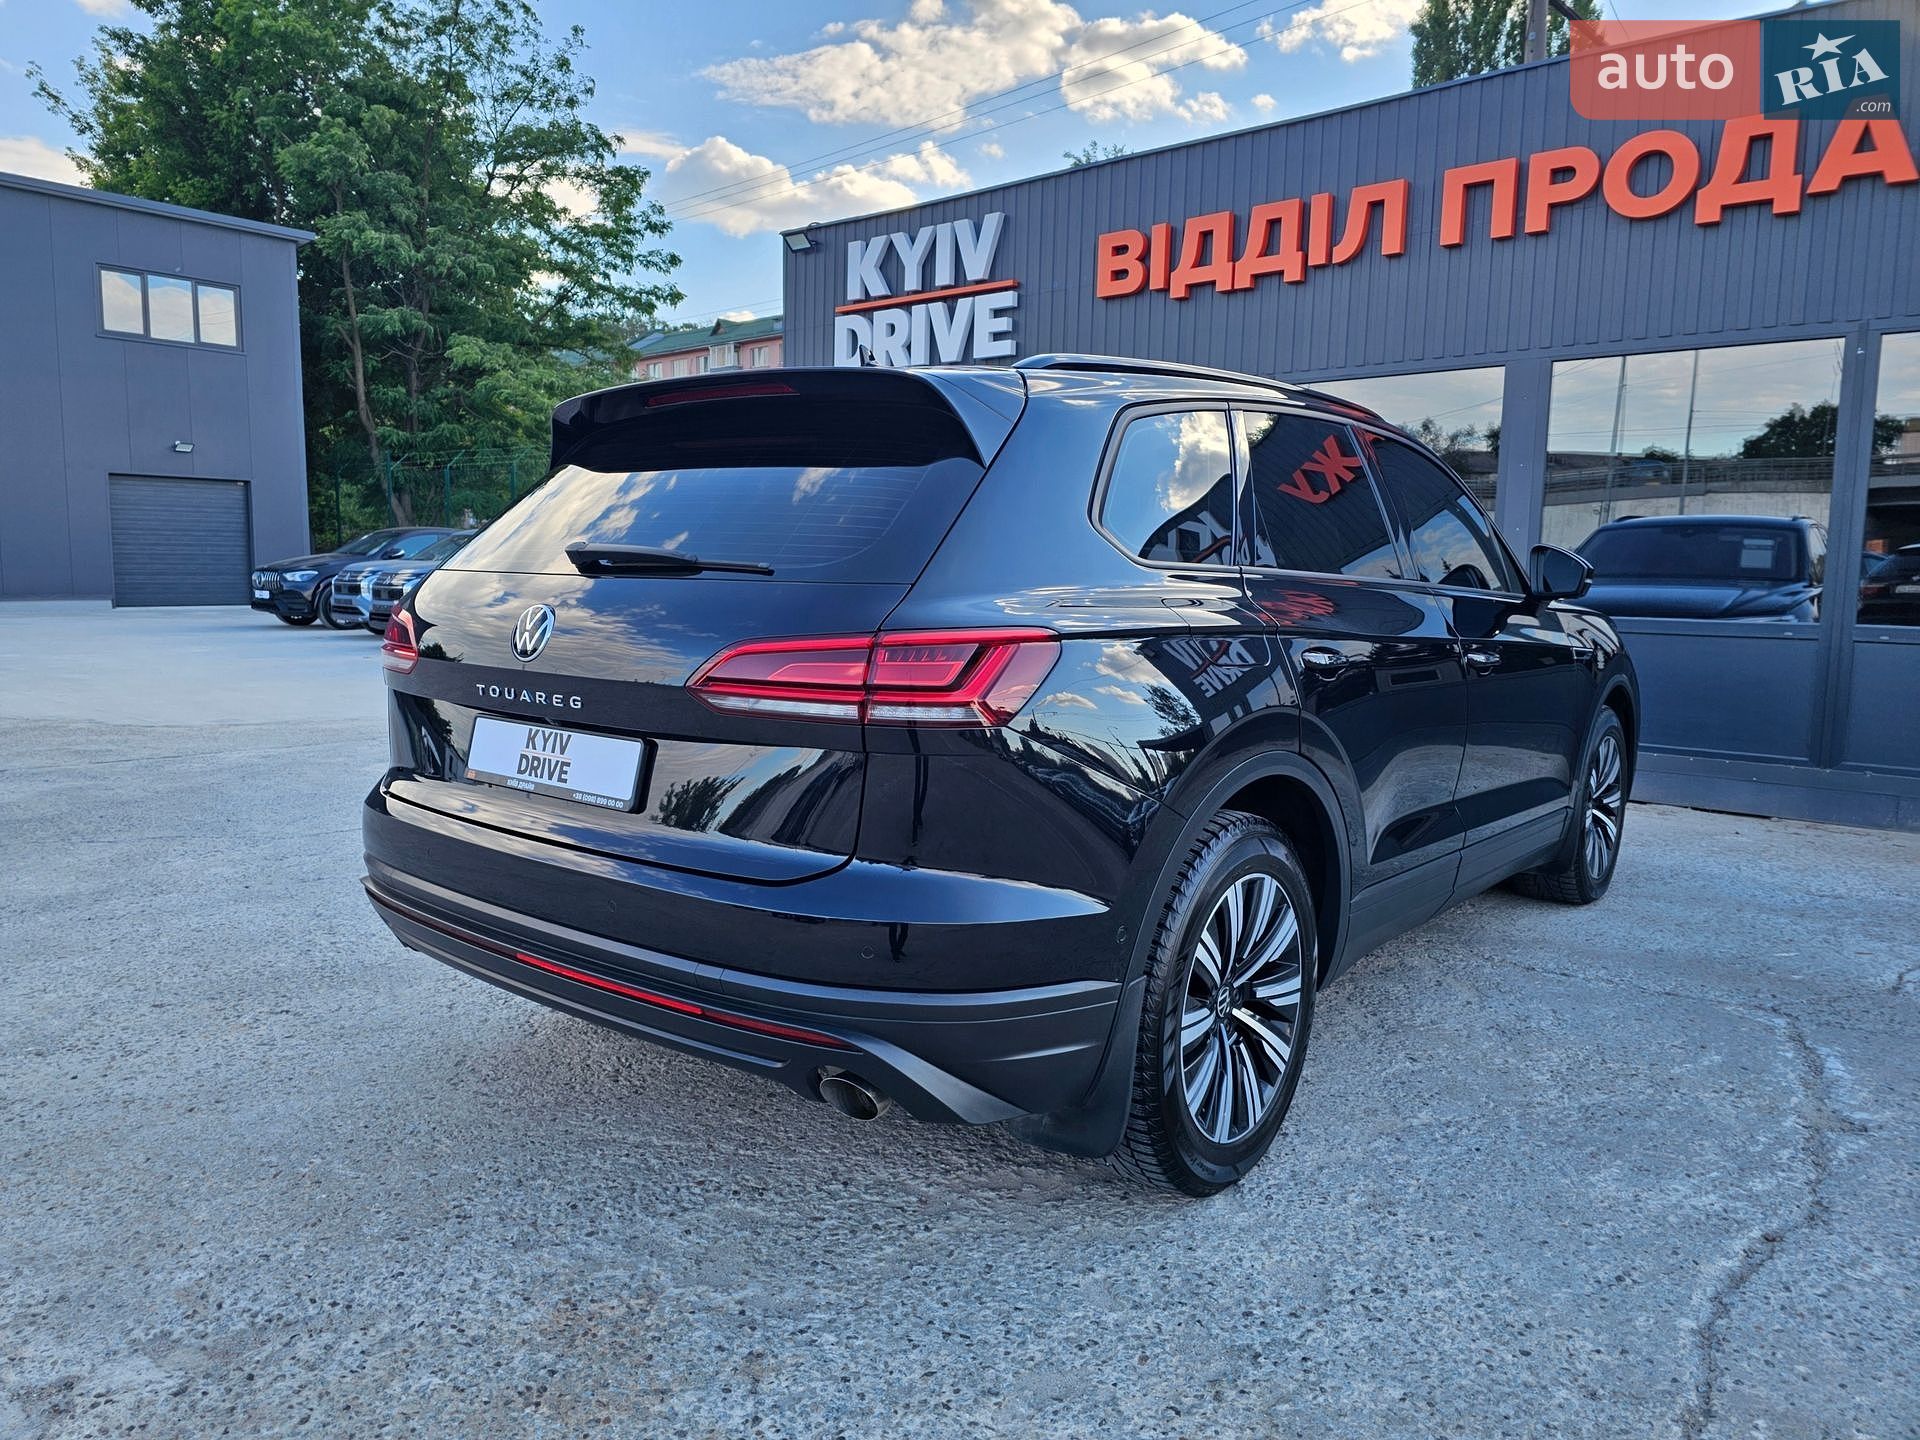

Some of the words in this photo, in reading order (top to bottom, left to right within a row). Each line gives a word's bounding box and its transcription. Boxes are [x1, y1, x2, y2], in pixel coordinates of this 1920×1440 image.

[1096, 178, 1410, 301] ВІДДІЛ
[1439, 93, 1920, 249] ПРОДА
[847, 212, 1006, 302] KYIV
[834, 291, 1018, 367] DRIVE
[476, 683, 583, 709] TOUAREG
[525, 727, 573, 756] KYIV
[516, 753, 571, 784] DRIVE
